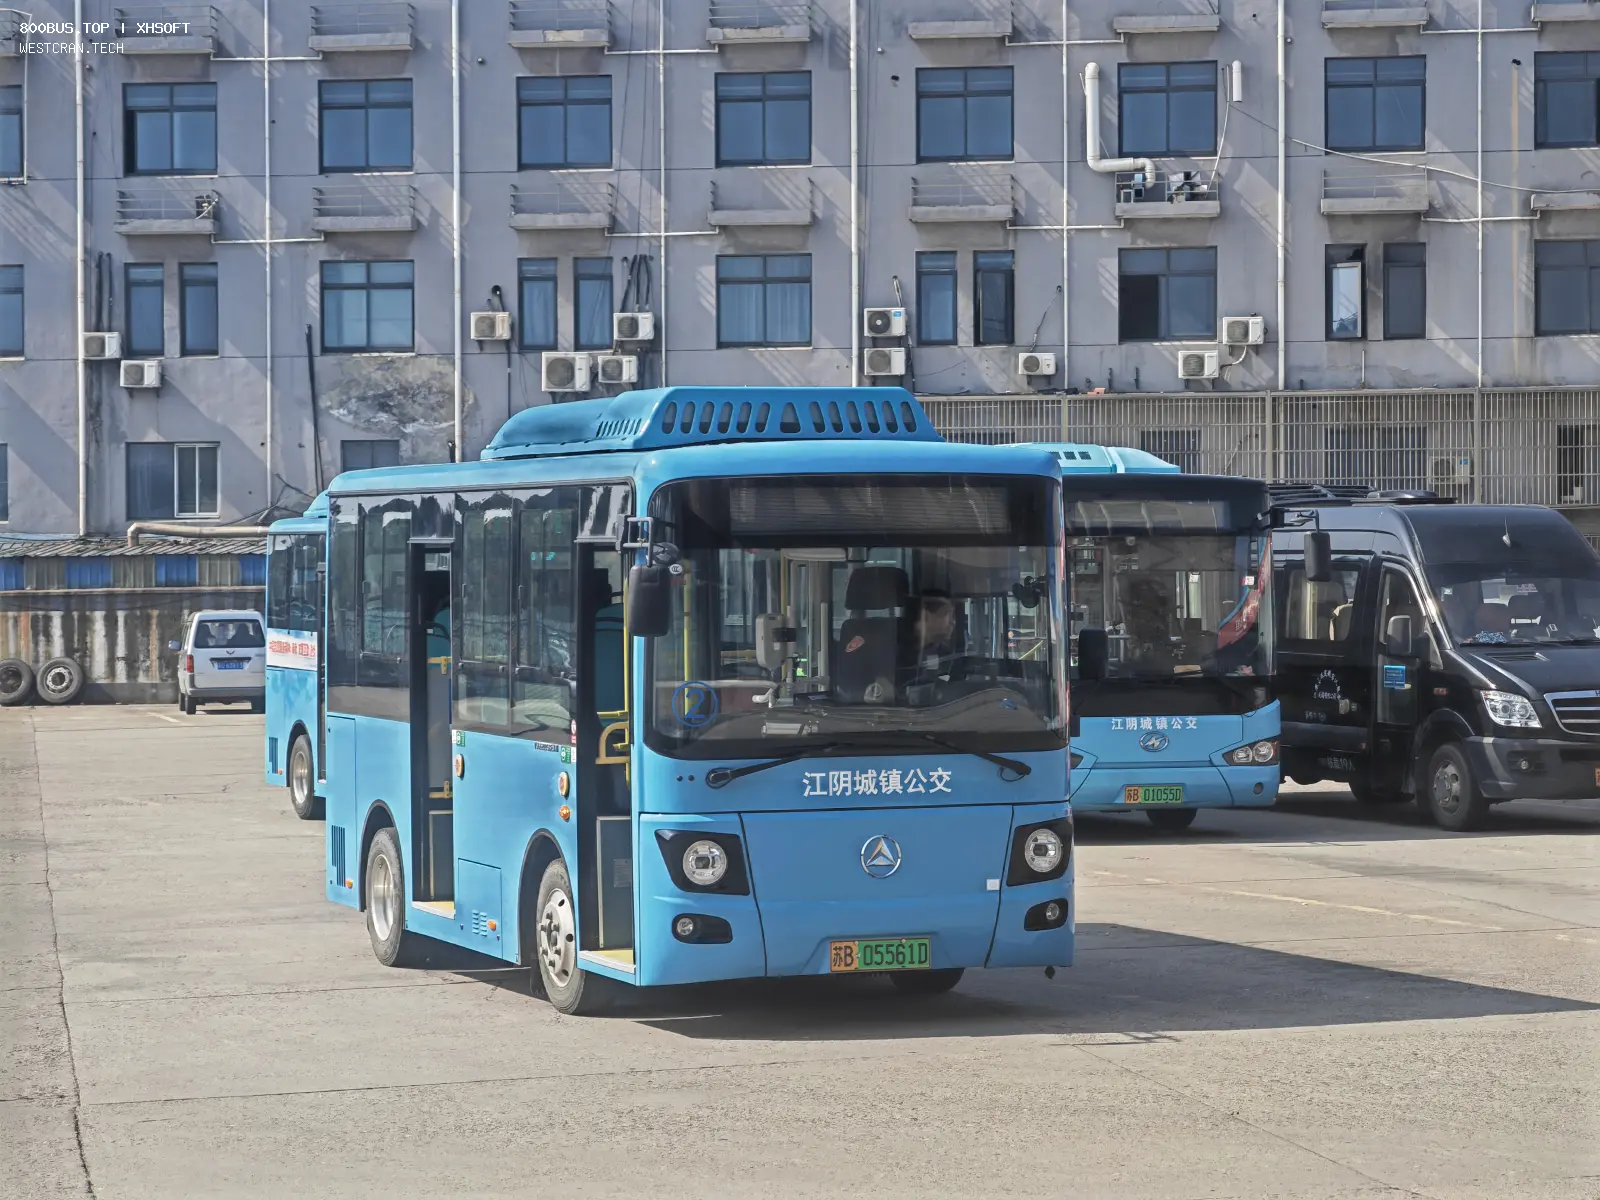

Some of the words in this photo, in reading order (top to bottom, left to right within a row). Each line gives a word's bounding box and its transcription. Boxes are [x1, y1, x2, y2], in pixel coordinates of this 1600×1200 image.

[1111, 716, 1198, 731] 江阴城镇公交
[802, 766, 952, 797] 江阴城镇公交
[1143, 788, 1182, 802] 01055D
[832, 945, 854, 967] 苏B
[863, 942, 928, 966] 05561D
